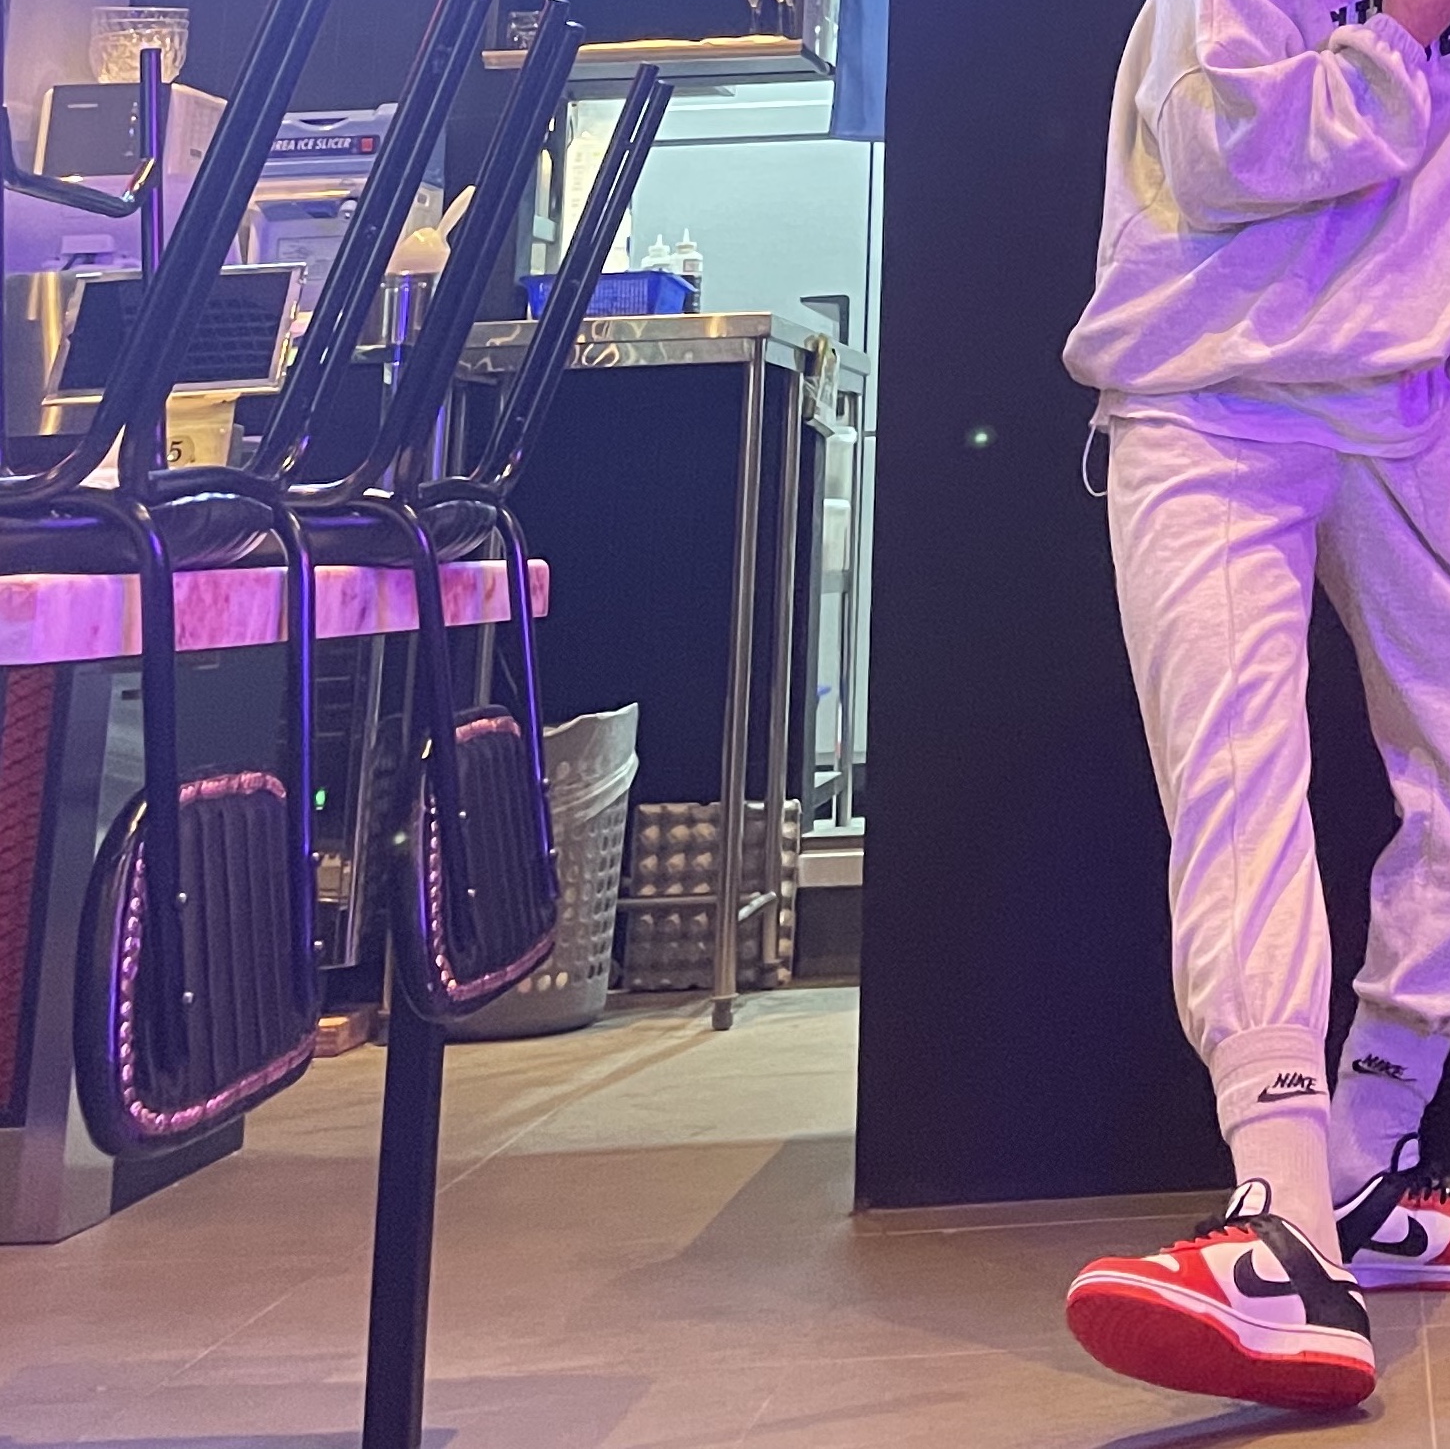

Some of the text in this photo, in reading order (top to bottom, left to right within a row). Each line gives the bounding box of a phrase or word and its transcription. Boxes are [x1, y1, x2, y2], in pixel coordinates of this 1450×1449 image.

[271, 137, 352, 151] REA ICE SLICER
[1361, 1053, 1408, 1079] NIKE
[1272, 1071, 1317, 1091] NIKE
